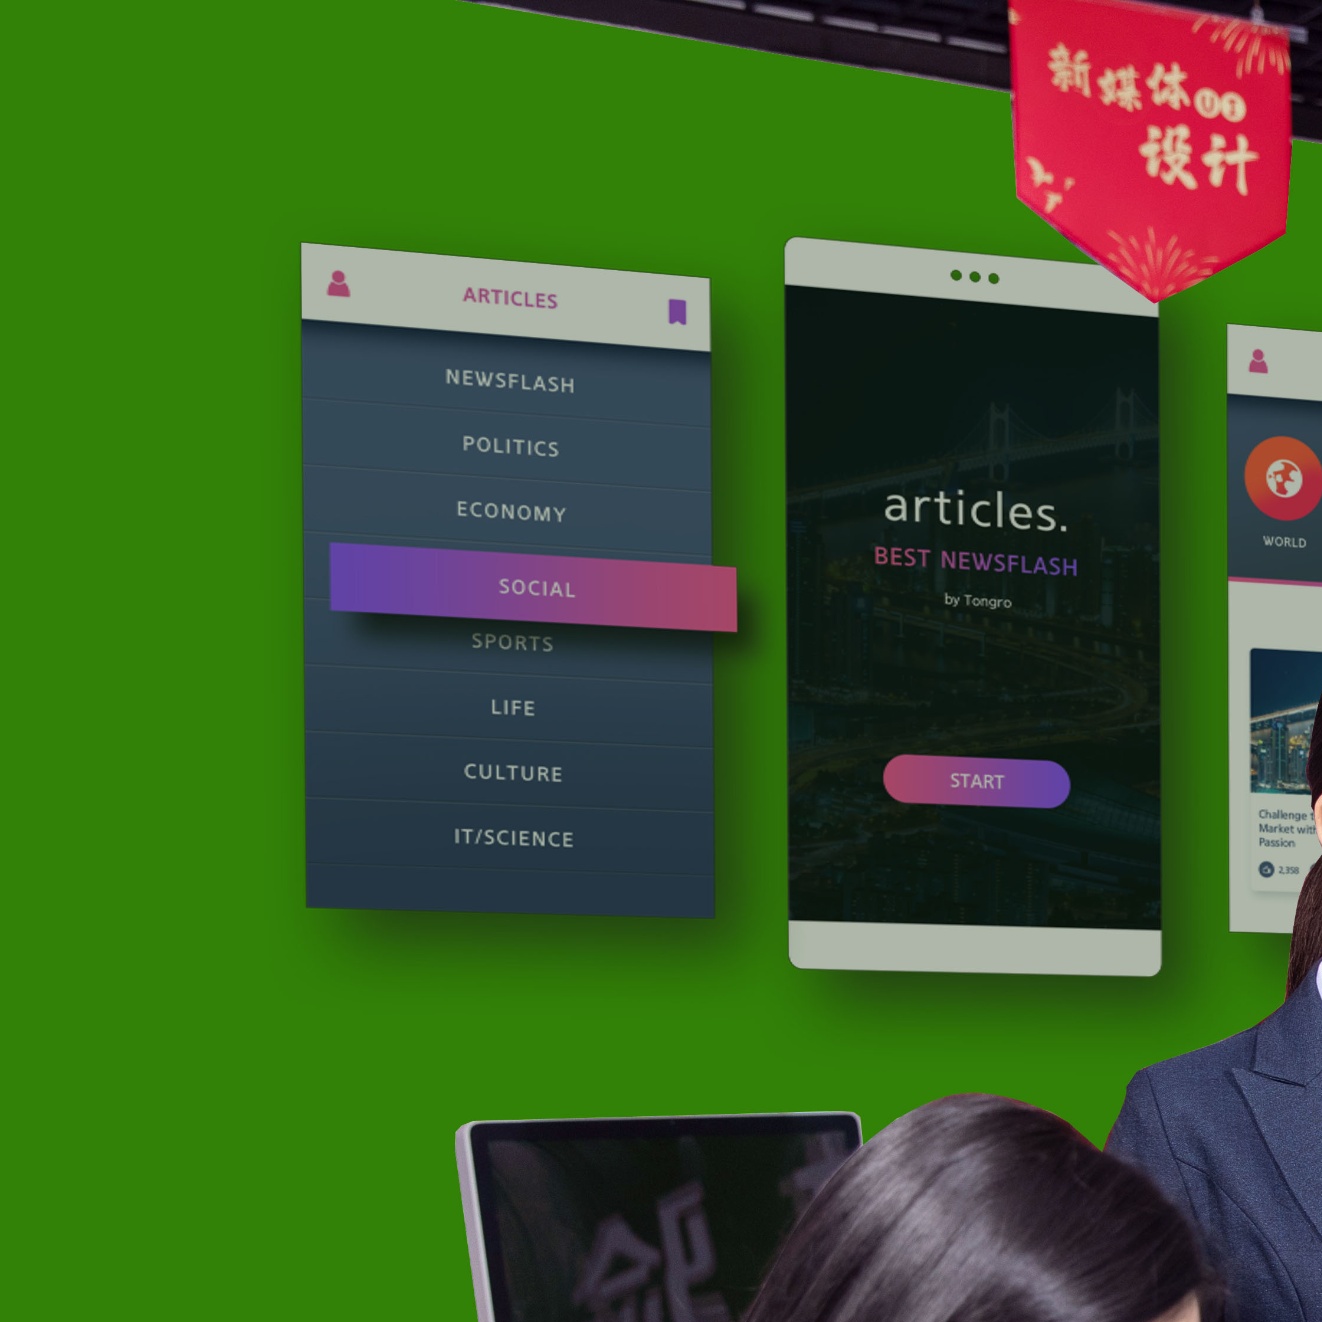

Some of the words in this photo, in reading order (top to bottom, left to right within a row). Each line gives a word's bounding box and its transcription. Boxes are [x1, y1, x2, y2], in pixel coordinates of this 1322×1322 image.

[1139, 123, 1260, 197] 设计
[463, 287, 558, 309] ARTICLES
[446, 368, 575, 394] NEWSFLASH
[462, 434, 560, 459] POLITICS
[457, 501, 566, 523] ECONOMY
[885, 489, 1067, 532] articles.
[1263, 535, 1307, 548] WORLD
[874, 546, 931, 568] BEST
[941, 550, 1077, 577] NEWSFLASH
[499, 578, 576, 598] SOCIAL
[945, 593, 960, 609] by
[964, 594, 1012, 610] Tongro
[472, 633, 553, 653] SPORTS
[491, 699, 535, 717] LIFE
[464, 763, 562, 783] CULTURE
[950, 772, 1005, 790] START
[1259, 809, 1307, 822] Challenge
[454, 828, 574, 848] IT/SCIENCE
[1259, 823, 1295, 834] Market
[1259, 837, 1296, 847] Passion
